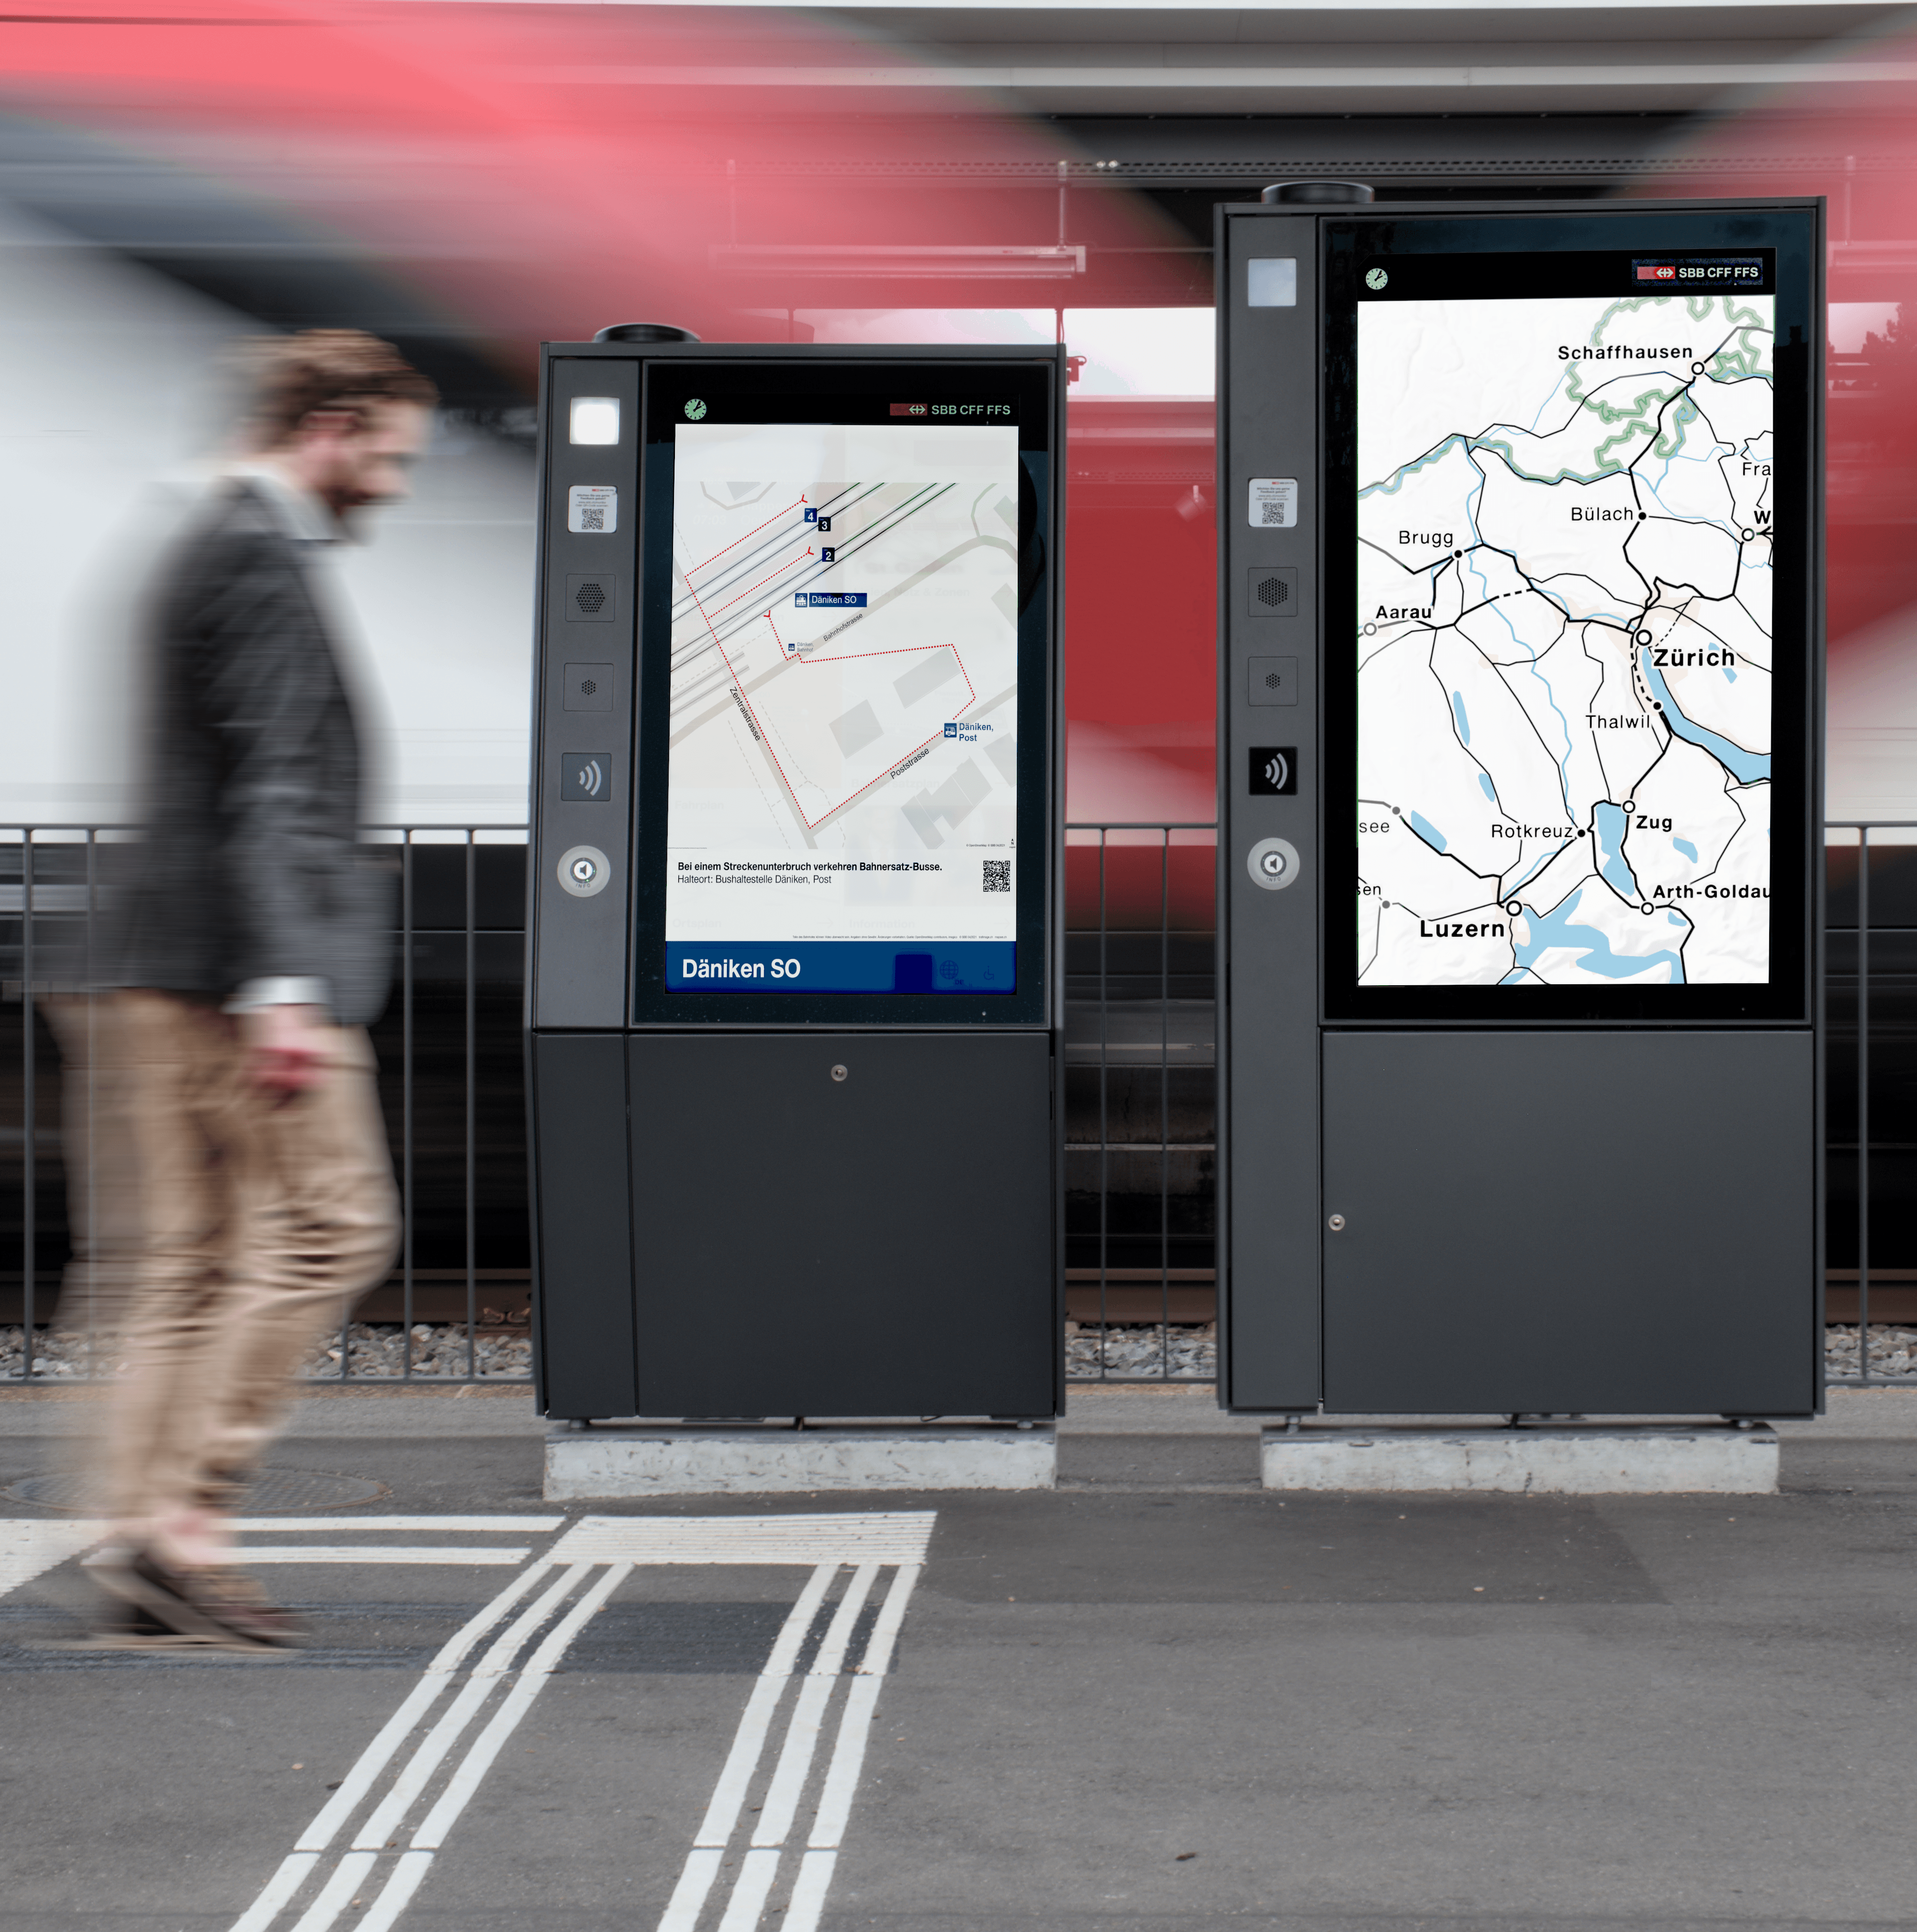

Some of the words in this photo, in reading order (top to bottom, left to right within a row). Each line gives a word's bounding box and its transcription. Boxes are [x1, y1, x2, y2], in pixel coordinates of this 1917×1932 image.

[1679, 268, 1705, 278] SBB
[1707, 267, 1732, 277] CFF
[1734, 267, 1759, 277] FFS
[1558, 345, 1692, 360] Schaffhausen
[932, 405, 957, 415] SBB
[959, 405, 984, 415] CFF
[987, 405, 1010, 415] FFS
[1743, 462, 1771, 476] Fra
[808, 512, 814, 521] 4
[1572, 507, 1633, 521] Bülach
[1754, 511, 1771, 524] W
[821, 521, 828, 530] 3
[1399, 530, 1453, 548] Brugg
[826, 552, 831, 560] 2
[844, 595, 857, 604] SO
[1375, 605, 1431, 619] Aarau
[823, 613, 864, 642] Bahnhofstrasse
[1652, 647, 1734, 667] Zürich
[729, 686, 761, 742] Zentralstrasse
[959, 723, 993, 732] Däniken,
[1585, 715, 1649, 729] Thalwil
[890, 747, 930, 780] Poststrasse
[1359, 822, 1389, 832] see
[1636, 815, 1672, 832] Zug
[1492, 824, 1573, 838] Rotkreuz
[678, 862, 692, 870] Bei
[694, 862, 721, 870] einem
[723, 862, 811, 871] Streckenunterbruch
[813, 862, 857, 871] verkehren
[860, 862, 942, 871] Bahnersatz-Busse.
[678, 875, 713, 883] Halteort:
[716, 875, 772, 883] Bushaltestelle
[775, 875, 810, 884] Däniken,
[813, 875, 832, 883] Post
[1420, 918, 1504, 938] Luzern
[682, 959, 765, 978] Däniken
[770, 958, 801, 978] SO
